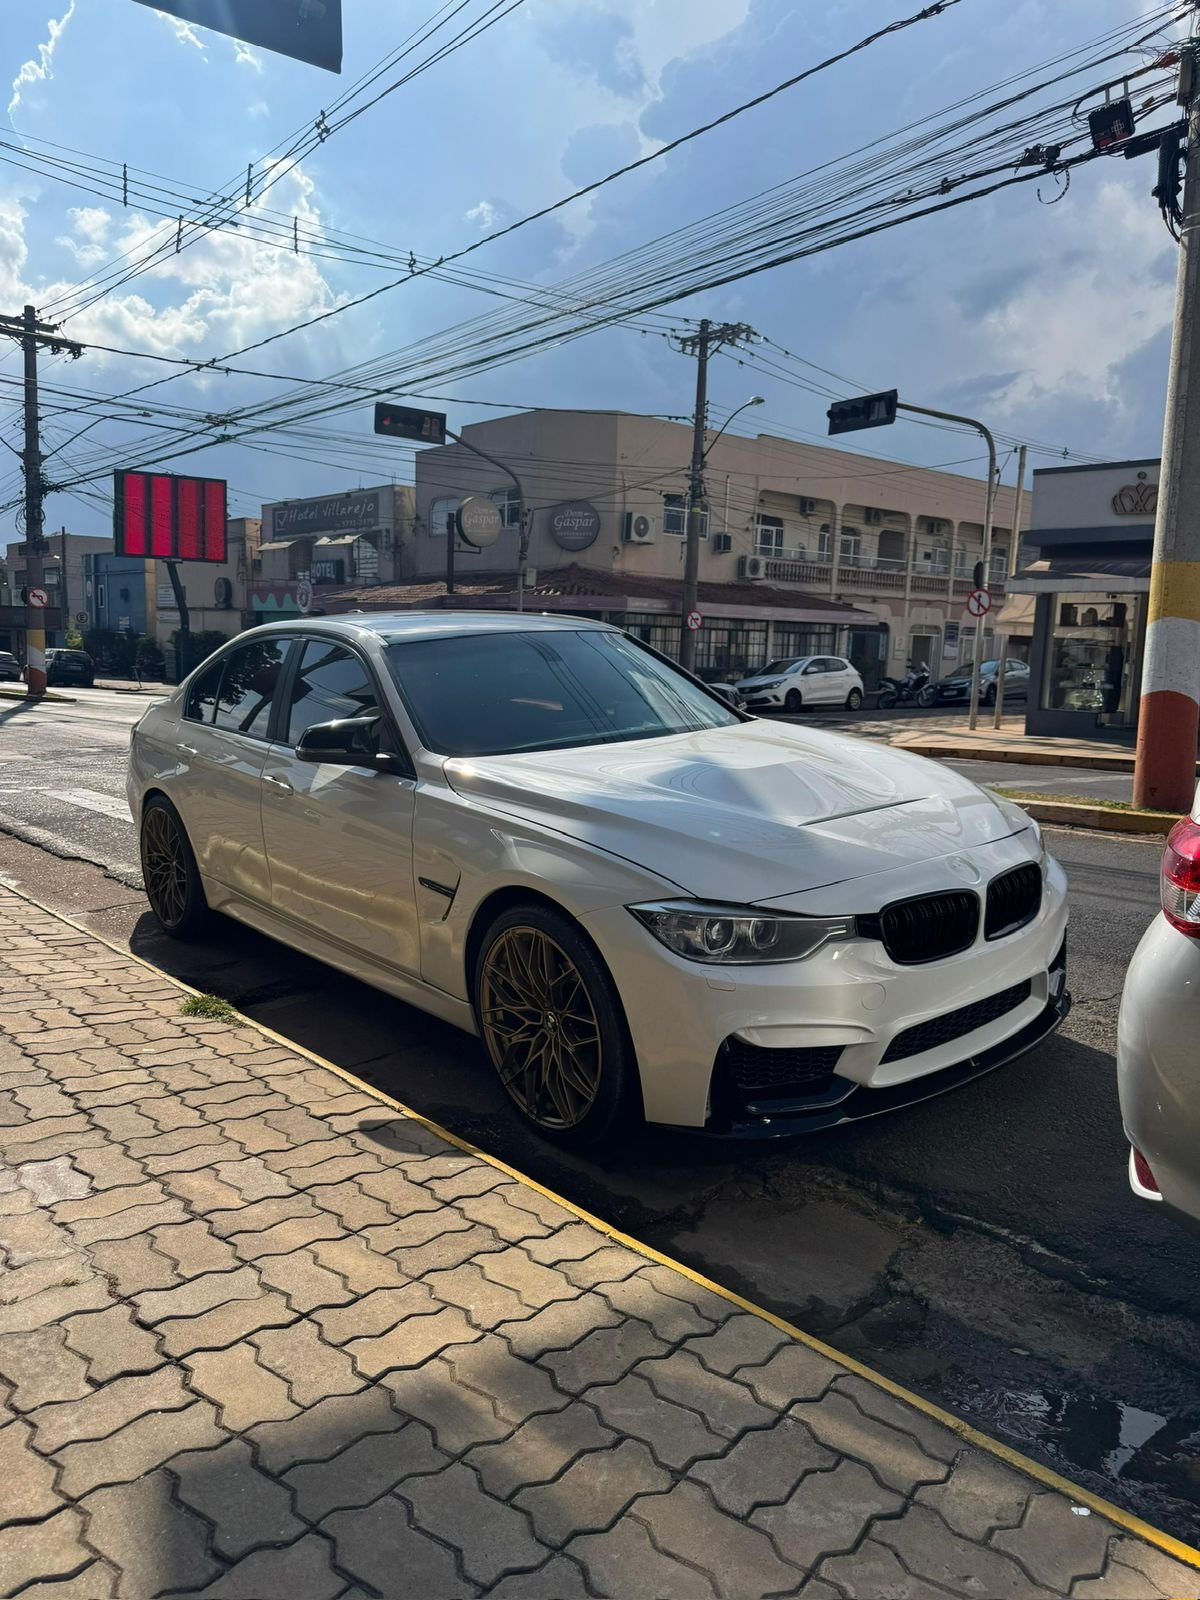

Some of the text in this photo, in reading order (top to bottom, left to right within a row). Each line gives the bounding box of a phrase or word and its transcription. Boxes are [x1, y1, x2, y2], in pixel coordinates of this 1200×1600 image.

[288, 498, 375, 523] Hotel Villarejo
[564, 509, 584, 517] Dom
[464, 511, 499, 528] Gaspar
[554, 514, 595, 531] Gaspar
[310, 562, 336, 579] HOTEL
